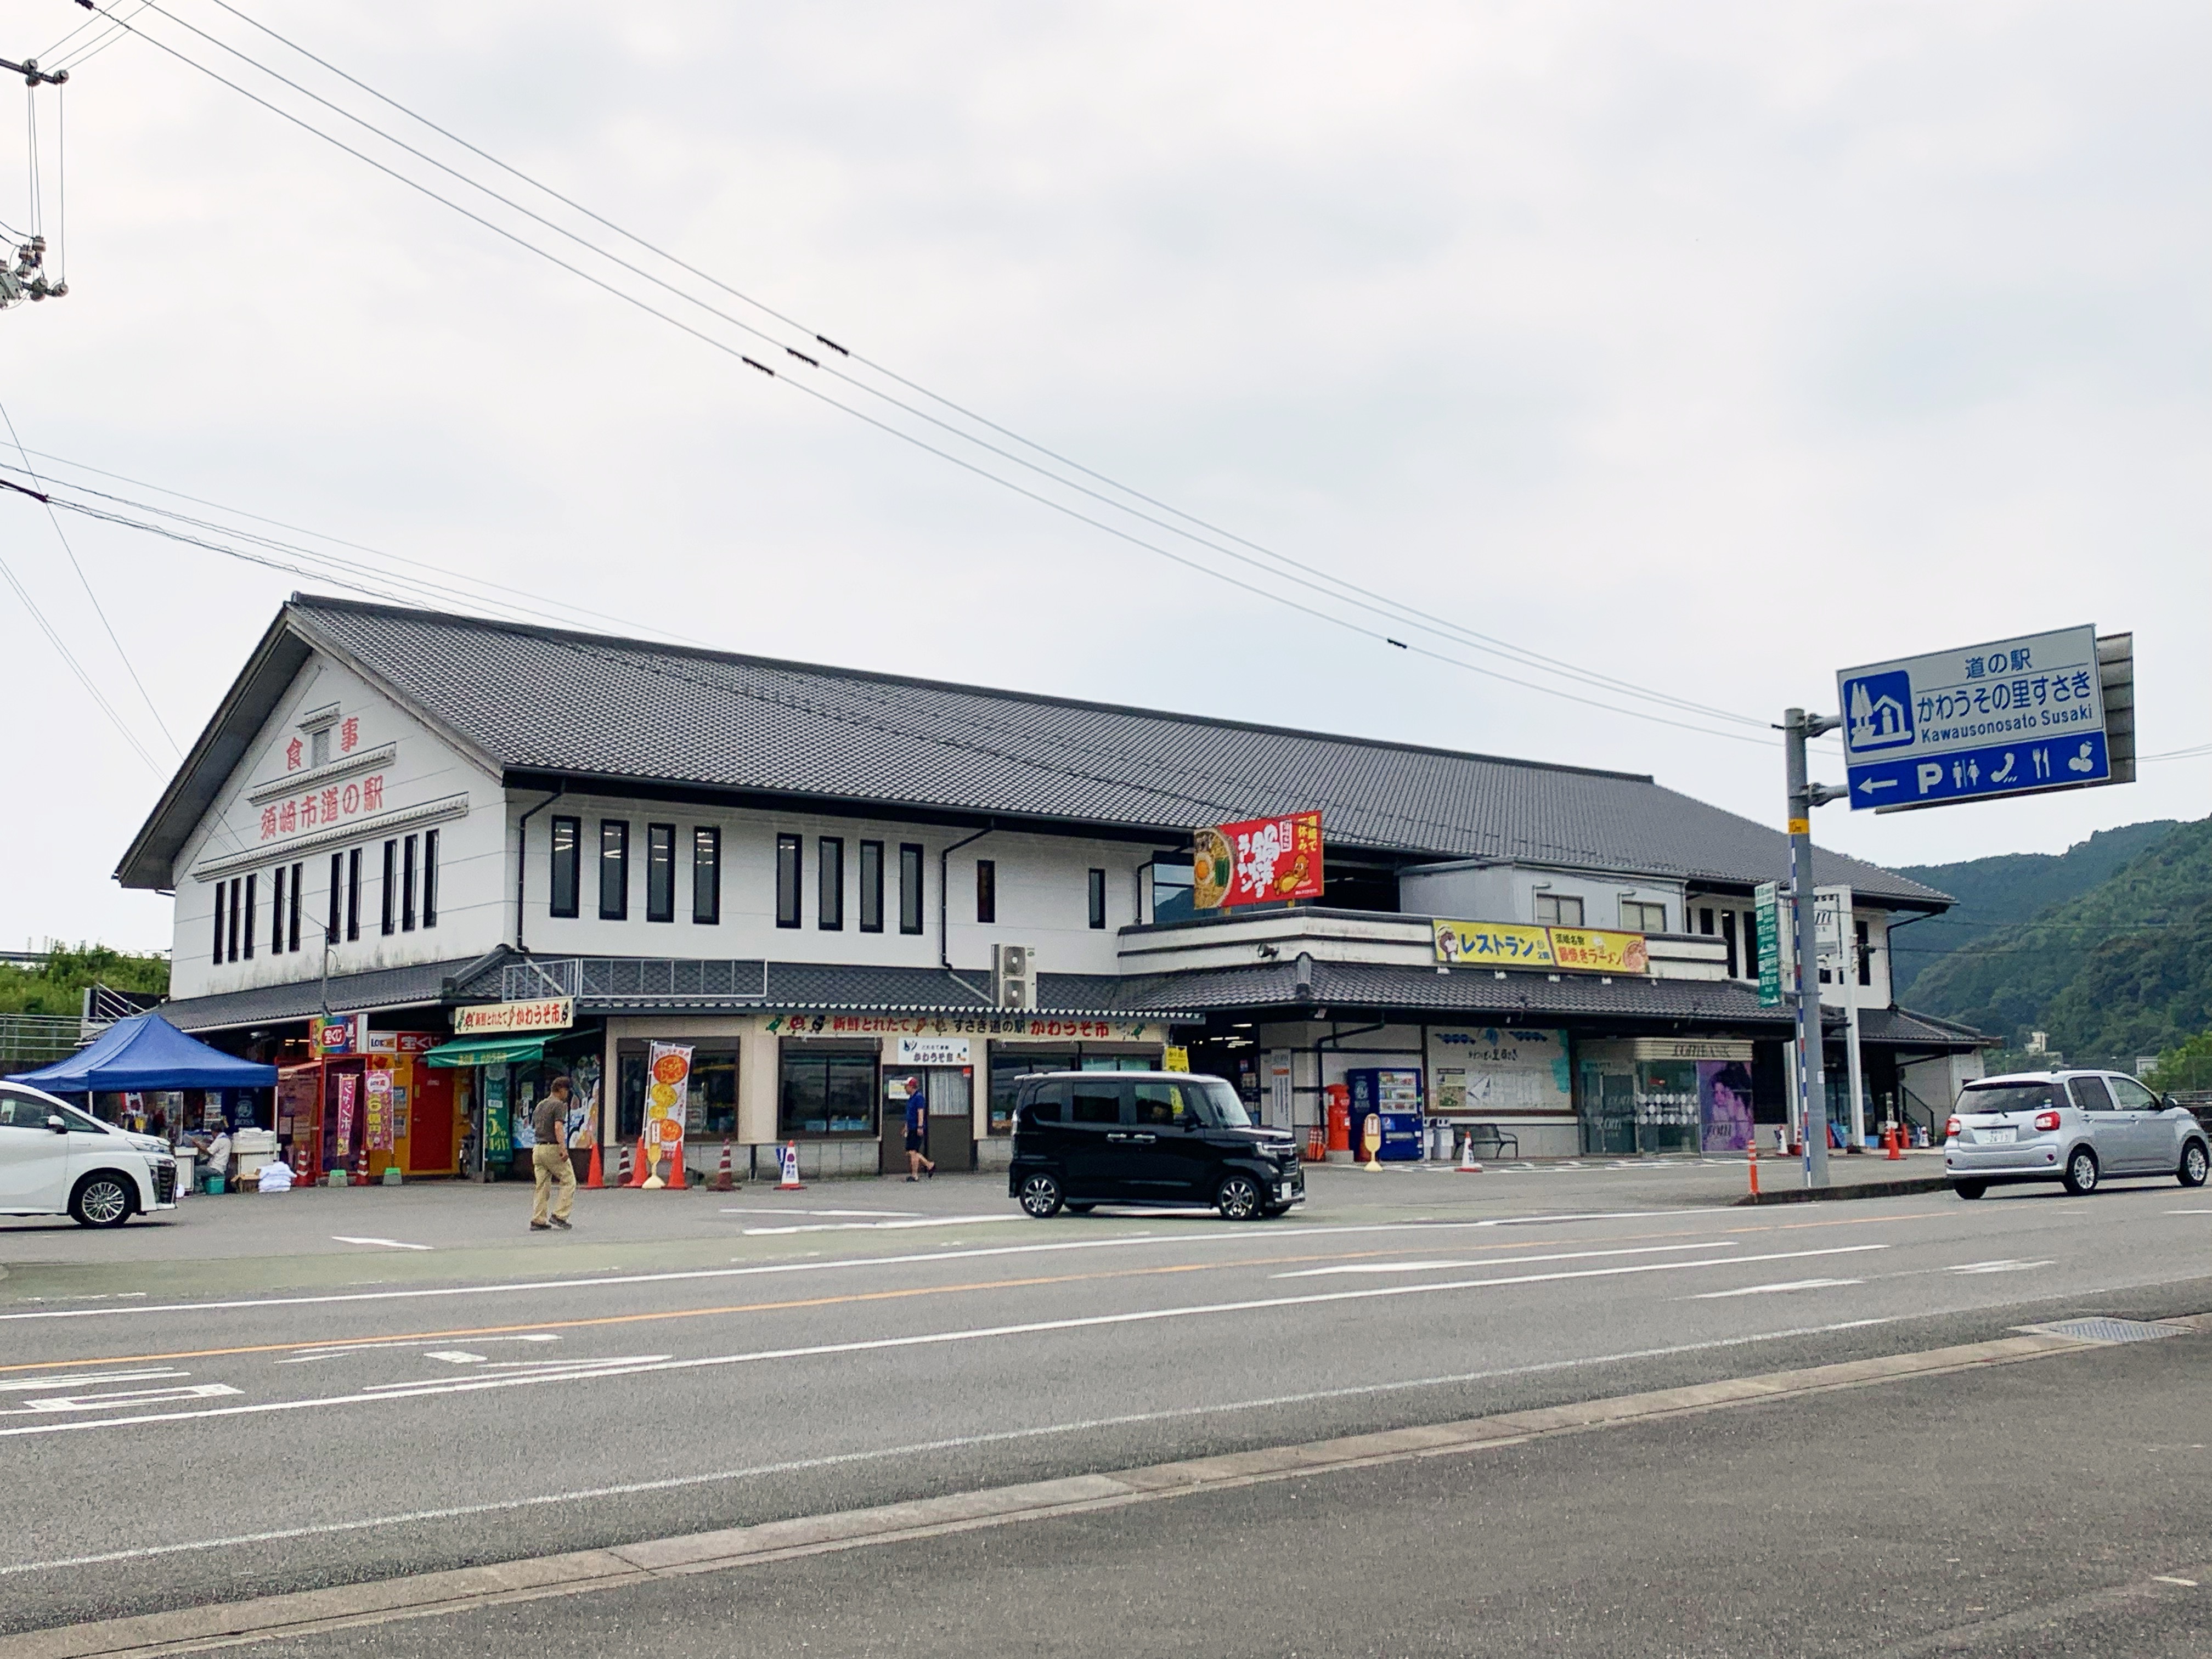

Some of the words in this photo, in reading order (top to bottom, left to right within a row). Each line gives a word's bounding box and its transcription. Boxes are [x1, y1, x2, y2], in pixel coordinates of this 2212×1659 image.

[1965, 647, 2032, 680] 道の駅
[1917, 671, 2091, 724] かわうその里すさき
[1921, 715, 2036, 743] Kawausonosato
[2042, 704, 2092, 726] Susaki
[1917, 763, 1943, 794] P
[261, 775, 383, 840] 須崎市道の駅
[1461, 933, 1534, 957] レストラン
[516, 1003, 560, 1025] かわうそ市
[833, 1015, 910, 1032] 新鮮とれたて
[953, 1018, 1025, 1034] すさき道の駅
[1030, 1019, 1109, 1038] かわうそ市
